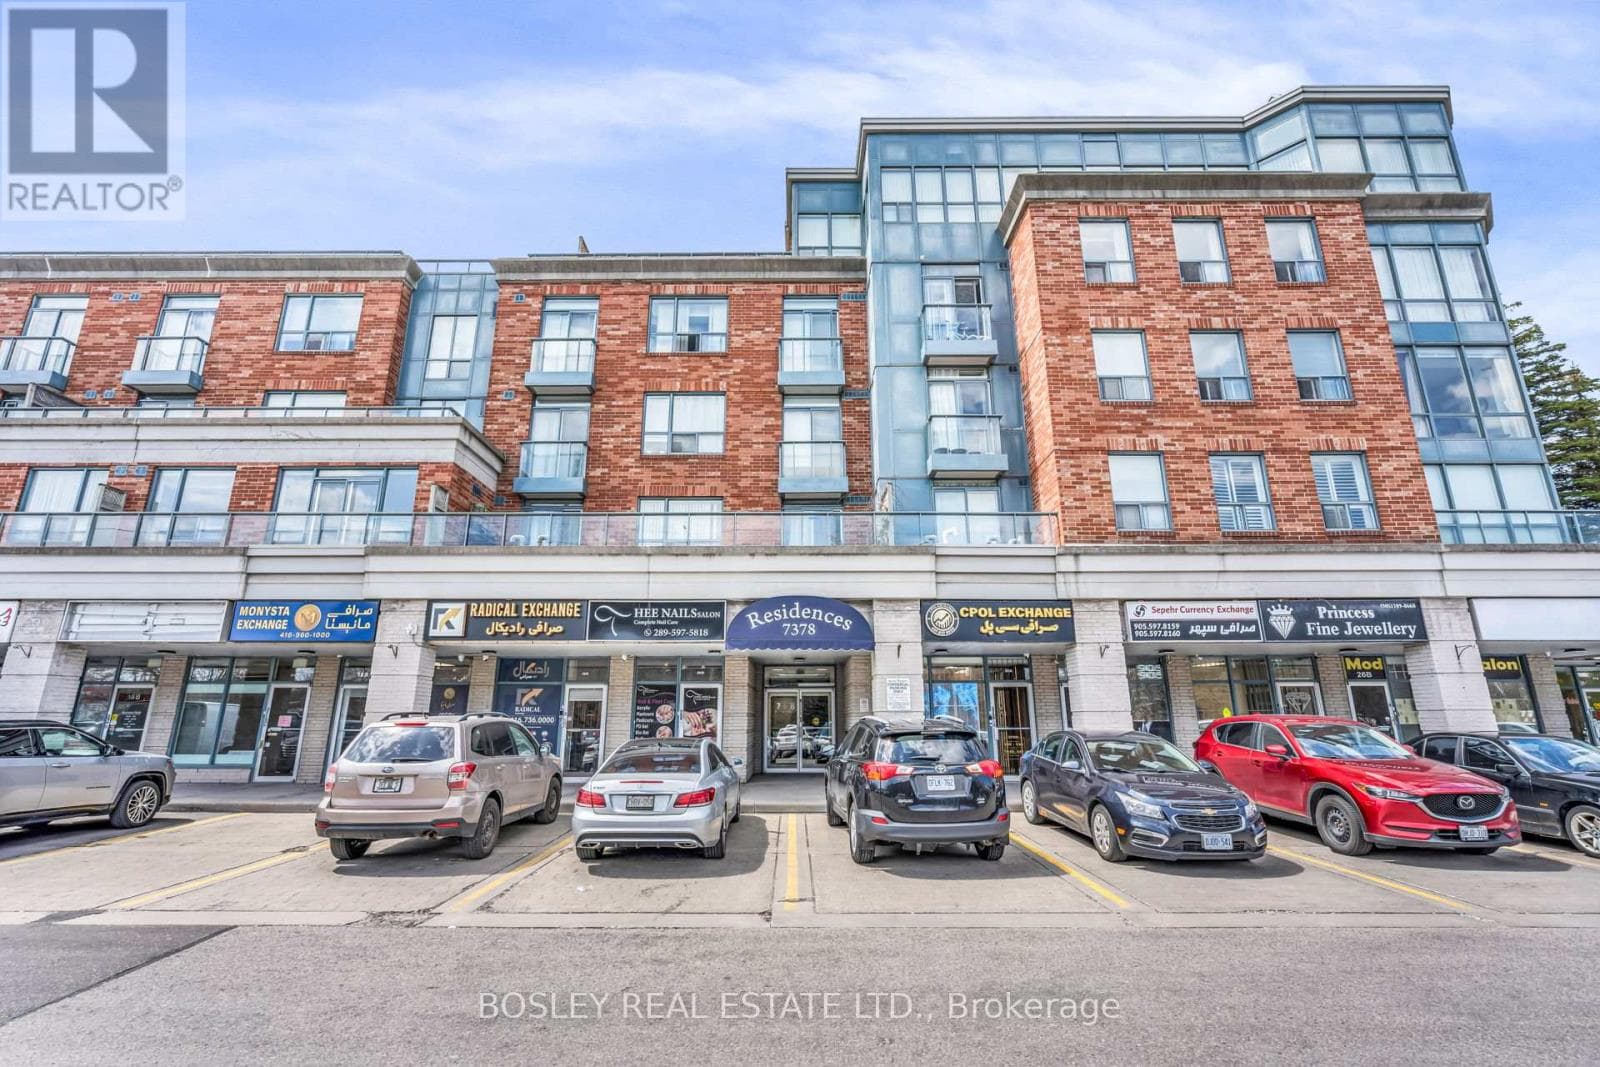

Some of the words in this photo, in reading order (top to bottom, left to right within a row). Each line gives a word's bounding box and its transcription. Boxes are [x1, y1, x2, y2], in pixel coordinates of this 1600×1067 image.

[239, 606, 290, 617] MONYSTA
[470, 602, 517, 617] RADICAL
[522, 602, 581, 617] EXCHANGE
[634, 608, 659, 618] HEE
[959, 607, 996, 618] CPOL
[999, 607, 1072, 618] EXCHANGE
[1151, 606, 1178, 615] Sepehr
[1180, 606, 1214, 615] Currency
[1217, 606, 1254, 615] Exchange
[1316, 606, 1375, 619] Princess
[746, 602, 853, 631] Residences
[236, 619, 288, 630] EXCHANGE
[782, 623, 816, 636] 7378
[1305, 622, 1340, 636] Fine
[1344, 621, 1416, 638] Jewellery
[653, 628, 709, 637] 289-597-5818
[1344, 657, 1383, 670] Mod
[1482, 657, 1518, 670] alon
